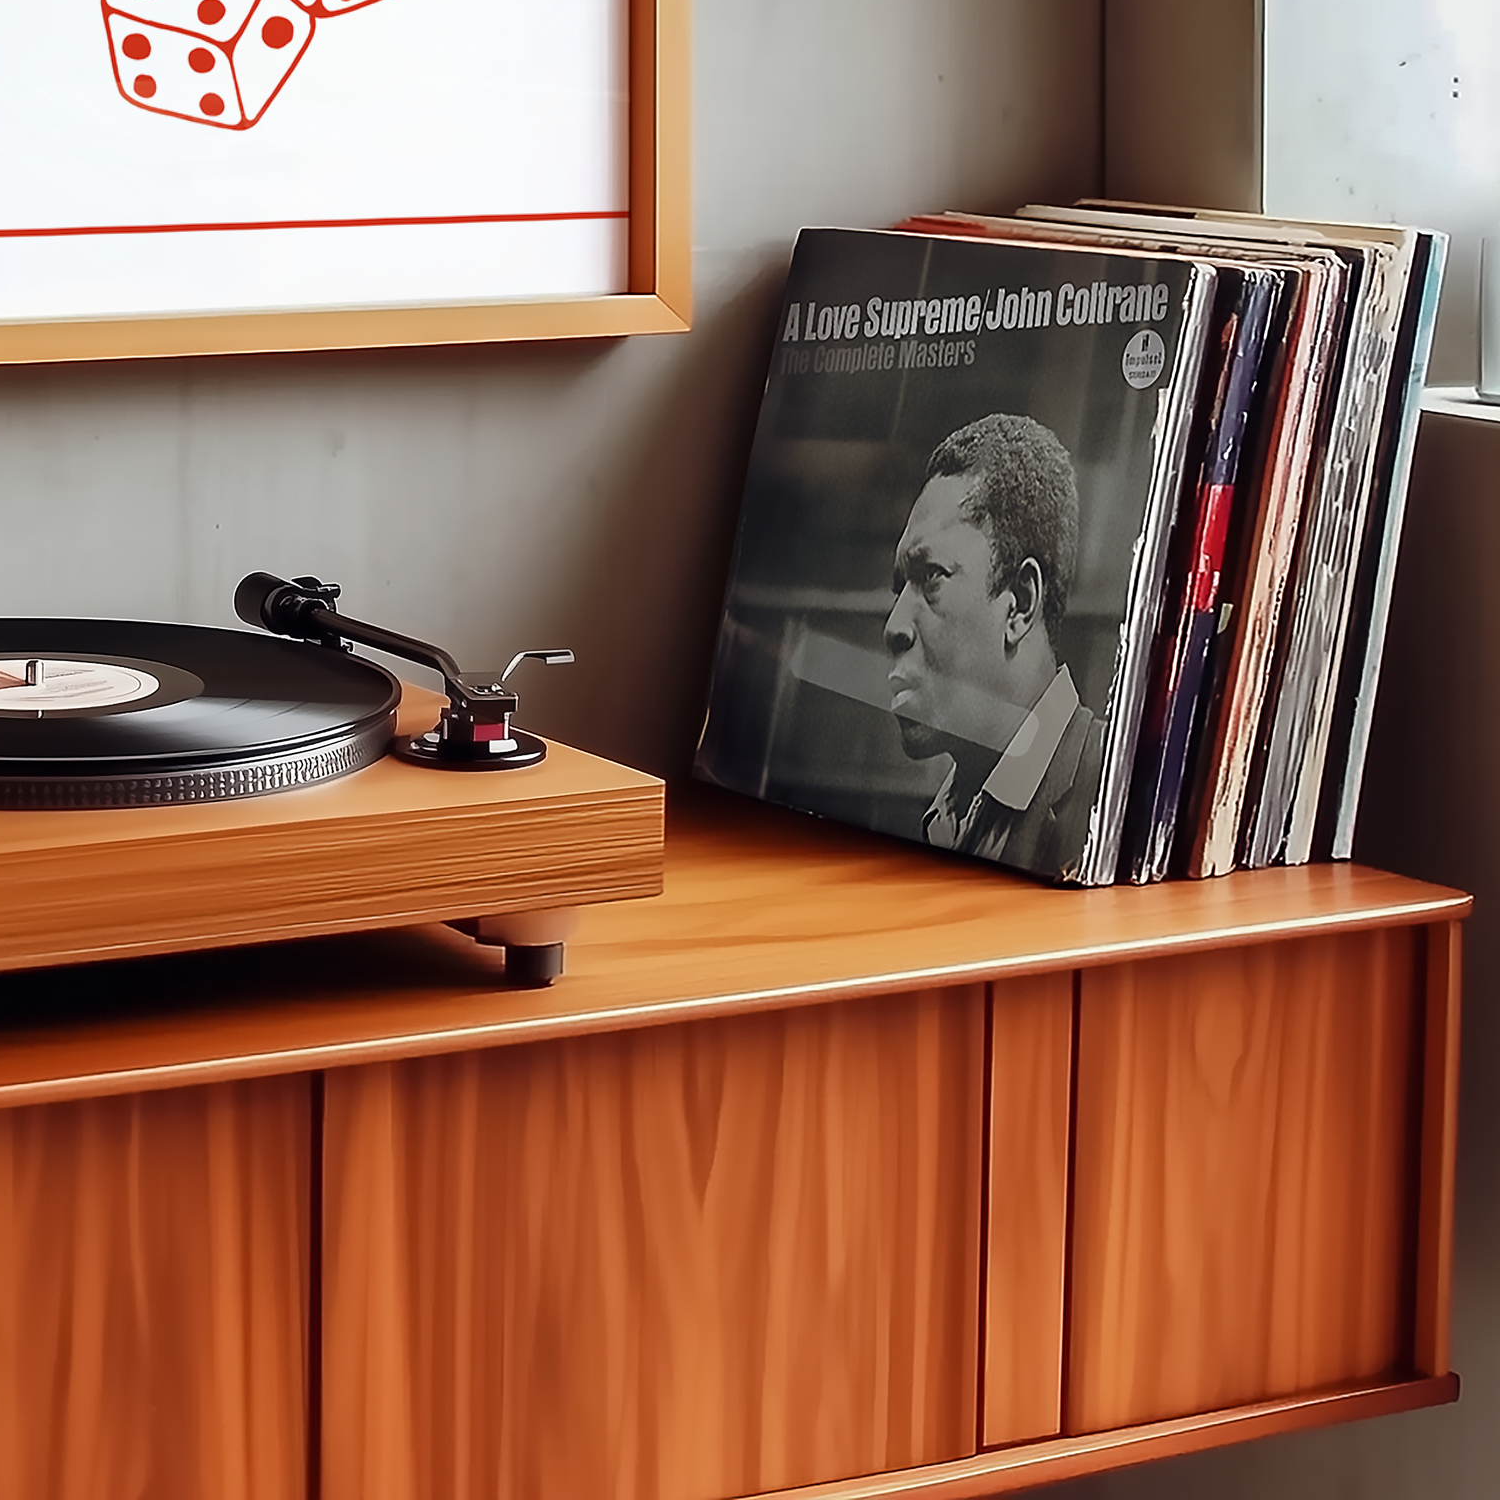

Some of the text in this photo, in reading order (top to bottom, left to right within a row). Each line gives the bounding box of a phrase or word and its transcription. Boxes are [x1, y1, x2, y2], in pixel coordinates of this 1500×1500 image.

[782, 303, 801, 342] A
[804, 302, 861, 342] Love
[1055, 281, 1169, 326] Coltrane
[779, 338, 977, 376] The Complete Masters
